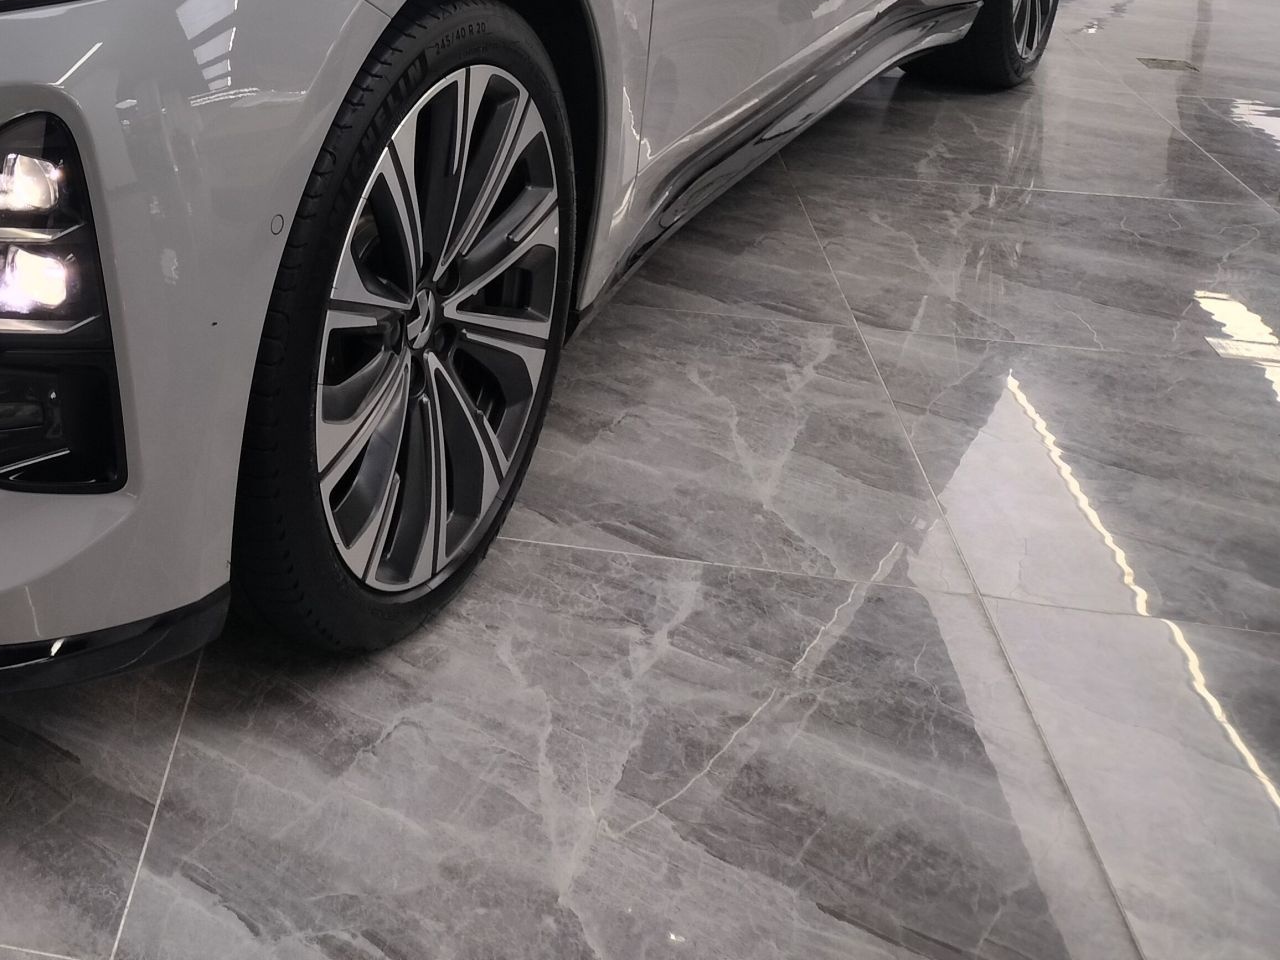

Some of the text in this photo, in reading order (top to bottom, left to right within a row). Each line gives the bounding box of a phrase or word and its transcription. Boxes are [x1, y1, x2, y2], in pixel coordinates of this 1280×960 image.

[434, 27, 466, 56] 245/40
[469, 22, 474, 34] R
[476, 21, 487, 33] 20
